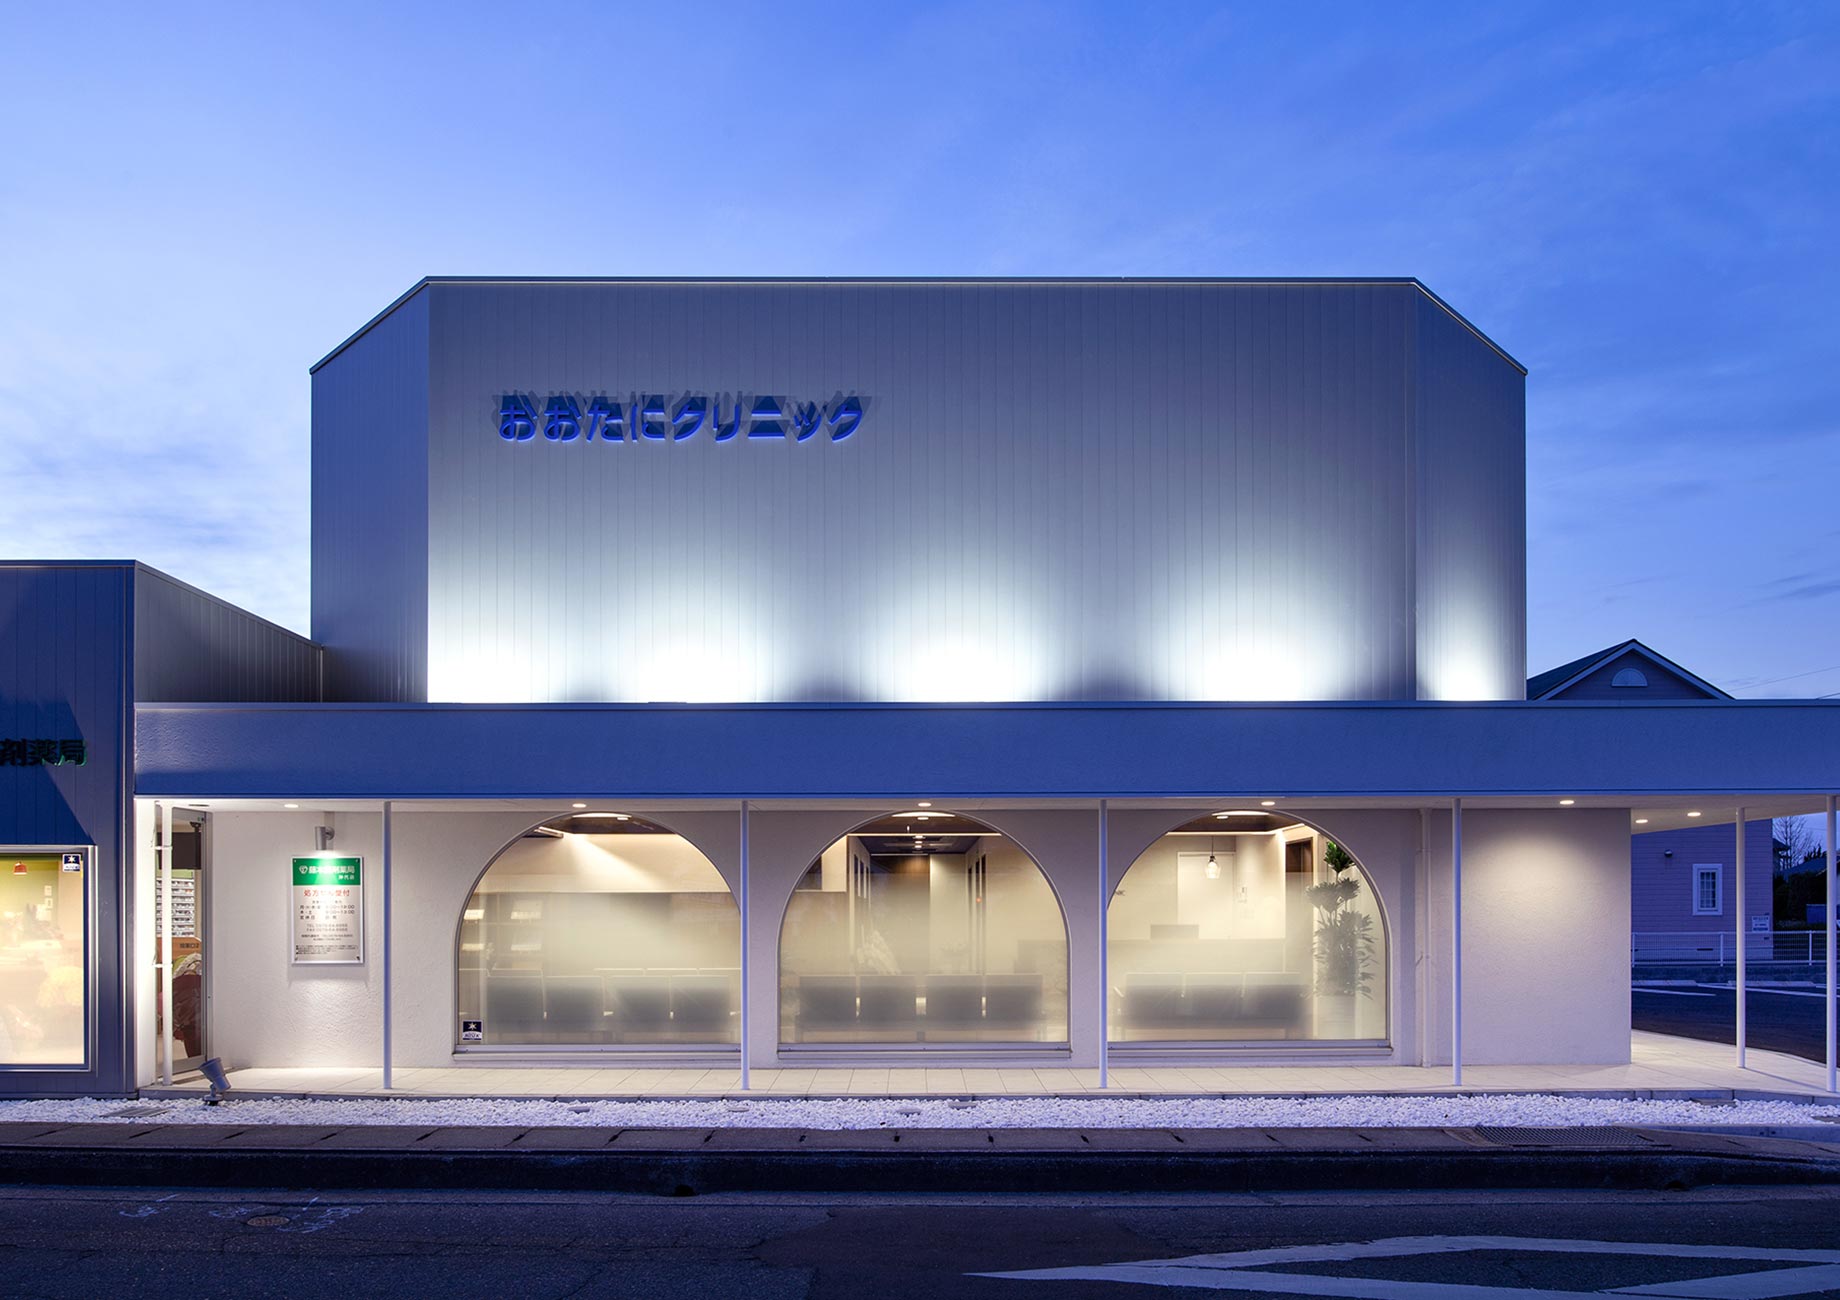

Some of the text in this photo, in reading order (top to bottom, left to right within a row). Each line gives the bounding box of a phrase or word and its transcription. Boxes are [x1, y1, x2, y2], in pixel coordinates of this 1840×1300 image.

[499, 395, 863, 443] おおたにクリニック
